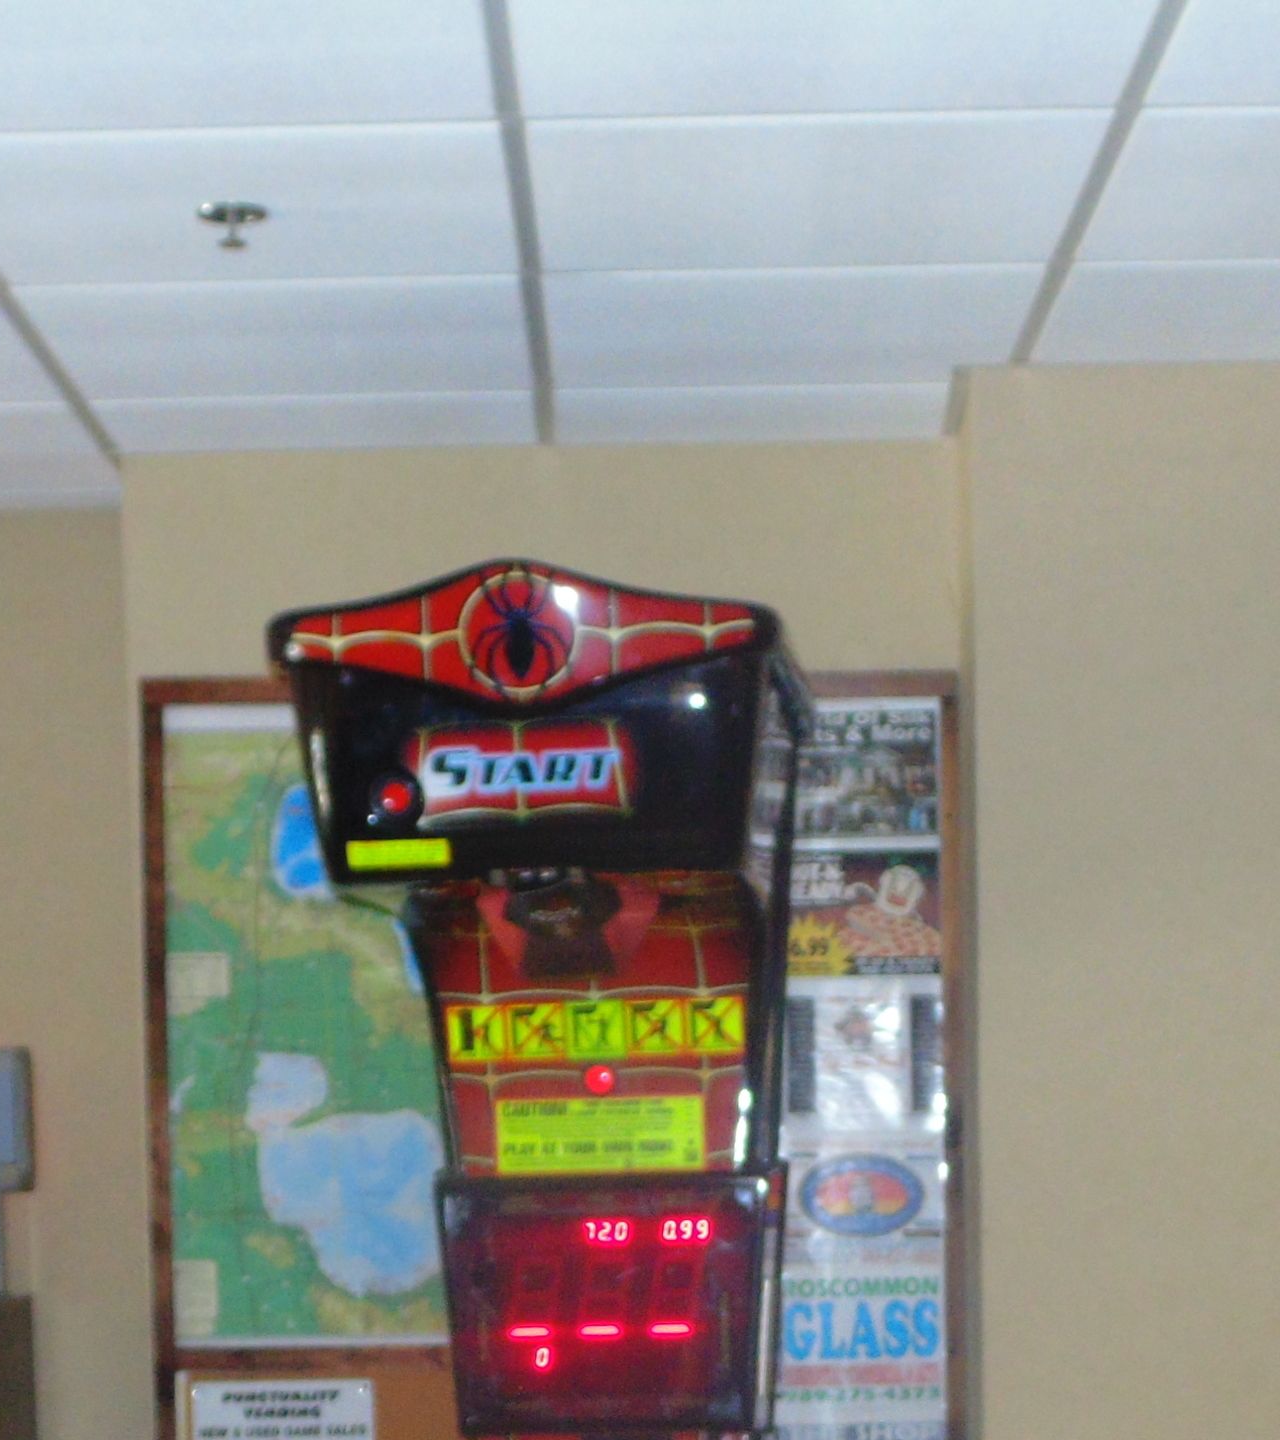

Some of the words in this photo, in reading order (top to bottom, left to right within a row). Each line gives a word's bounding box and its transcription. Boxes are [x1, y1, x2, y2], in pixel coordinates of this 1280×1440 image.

[786, 1275, 939, 1297] ROSCOMMON
[784, 1298, 940, 1361] GLASS
[535, 1347, 550, 1368] 0
